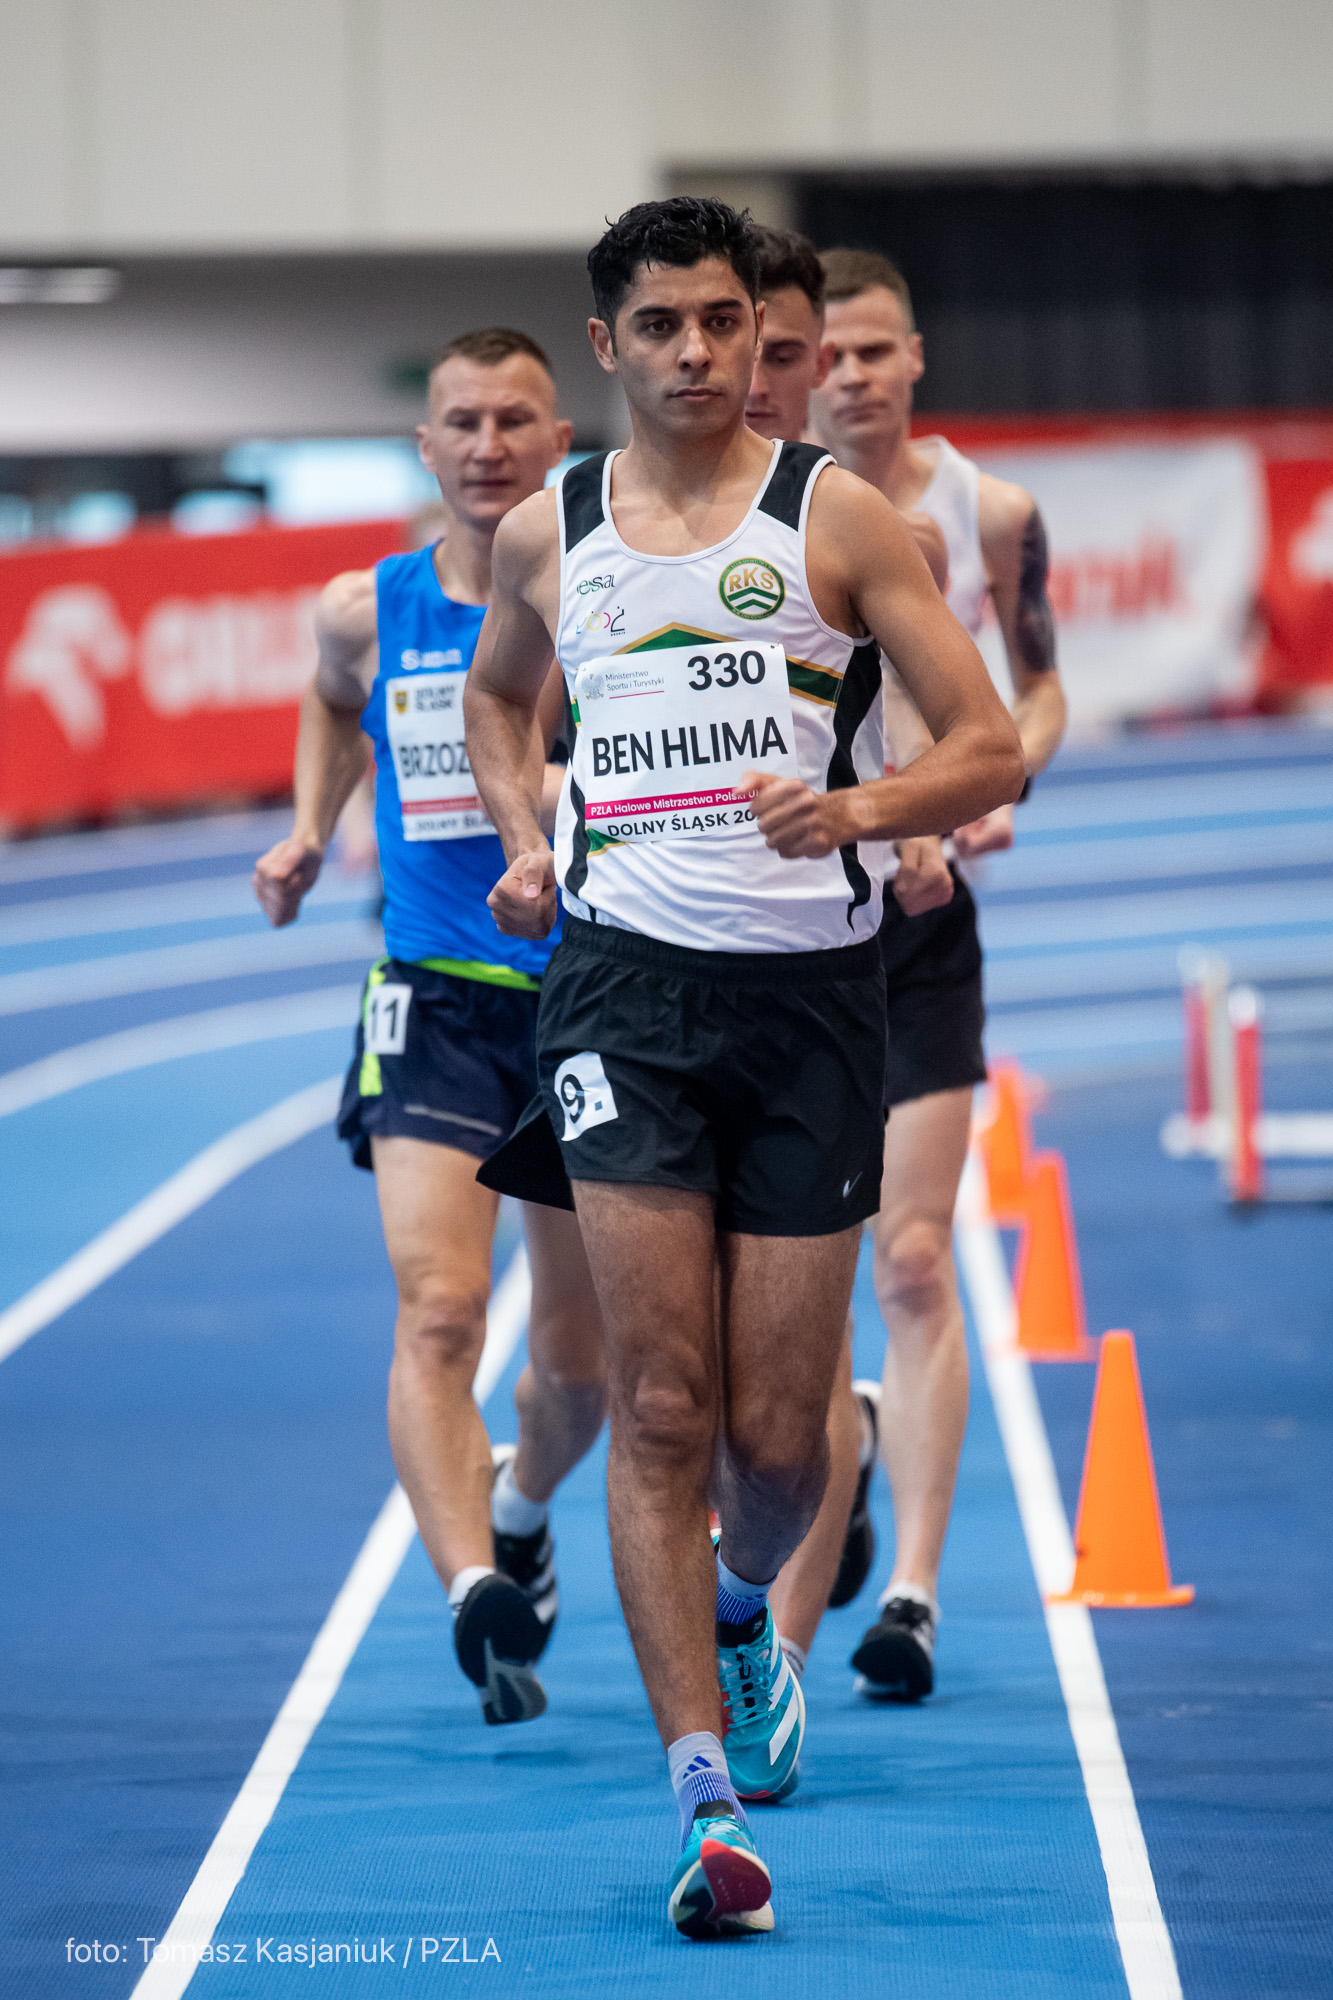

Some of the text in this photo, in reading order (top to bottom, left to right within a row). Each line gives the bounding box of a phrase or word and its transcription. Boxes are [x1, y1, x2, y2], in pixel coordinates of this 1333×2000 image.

[728, 567, 774, 593] RKS
[605, 670, 649, 681] Ministerstwo
[687, 650, 766, 691] 330
[606, 682, 629, 692] Sportu
[633, 677, 665, 688] Turystyki
[592, 716, 788, 777] BEN HLIMA
[590, 804, 613, 816] PZLA
[614, 800, 652, 814] Halowe
[653, 795, 714, 810] Mistrzostwa
[608, 819, 667, 837] DOLNY
[671, 812, 730, 832] ŚLĄSK
[371, 998, 398, 1041] 11
